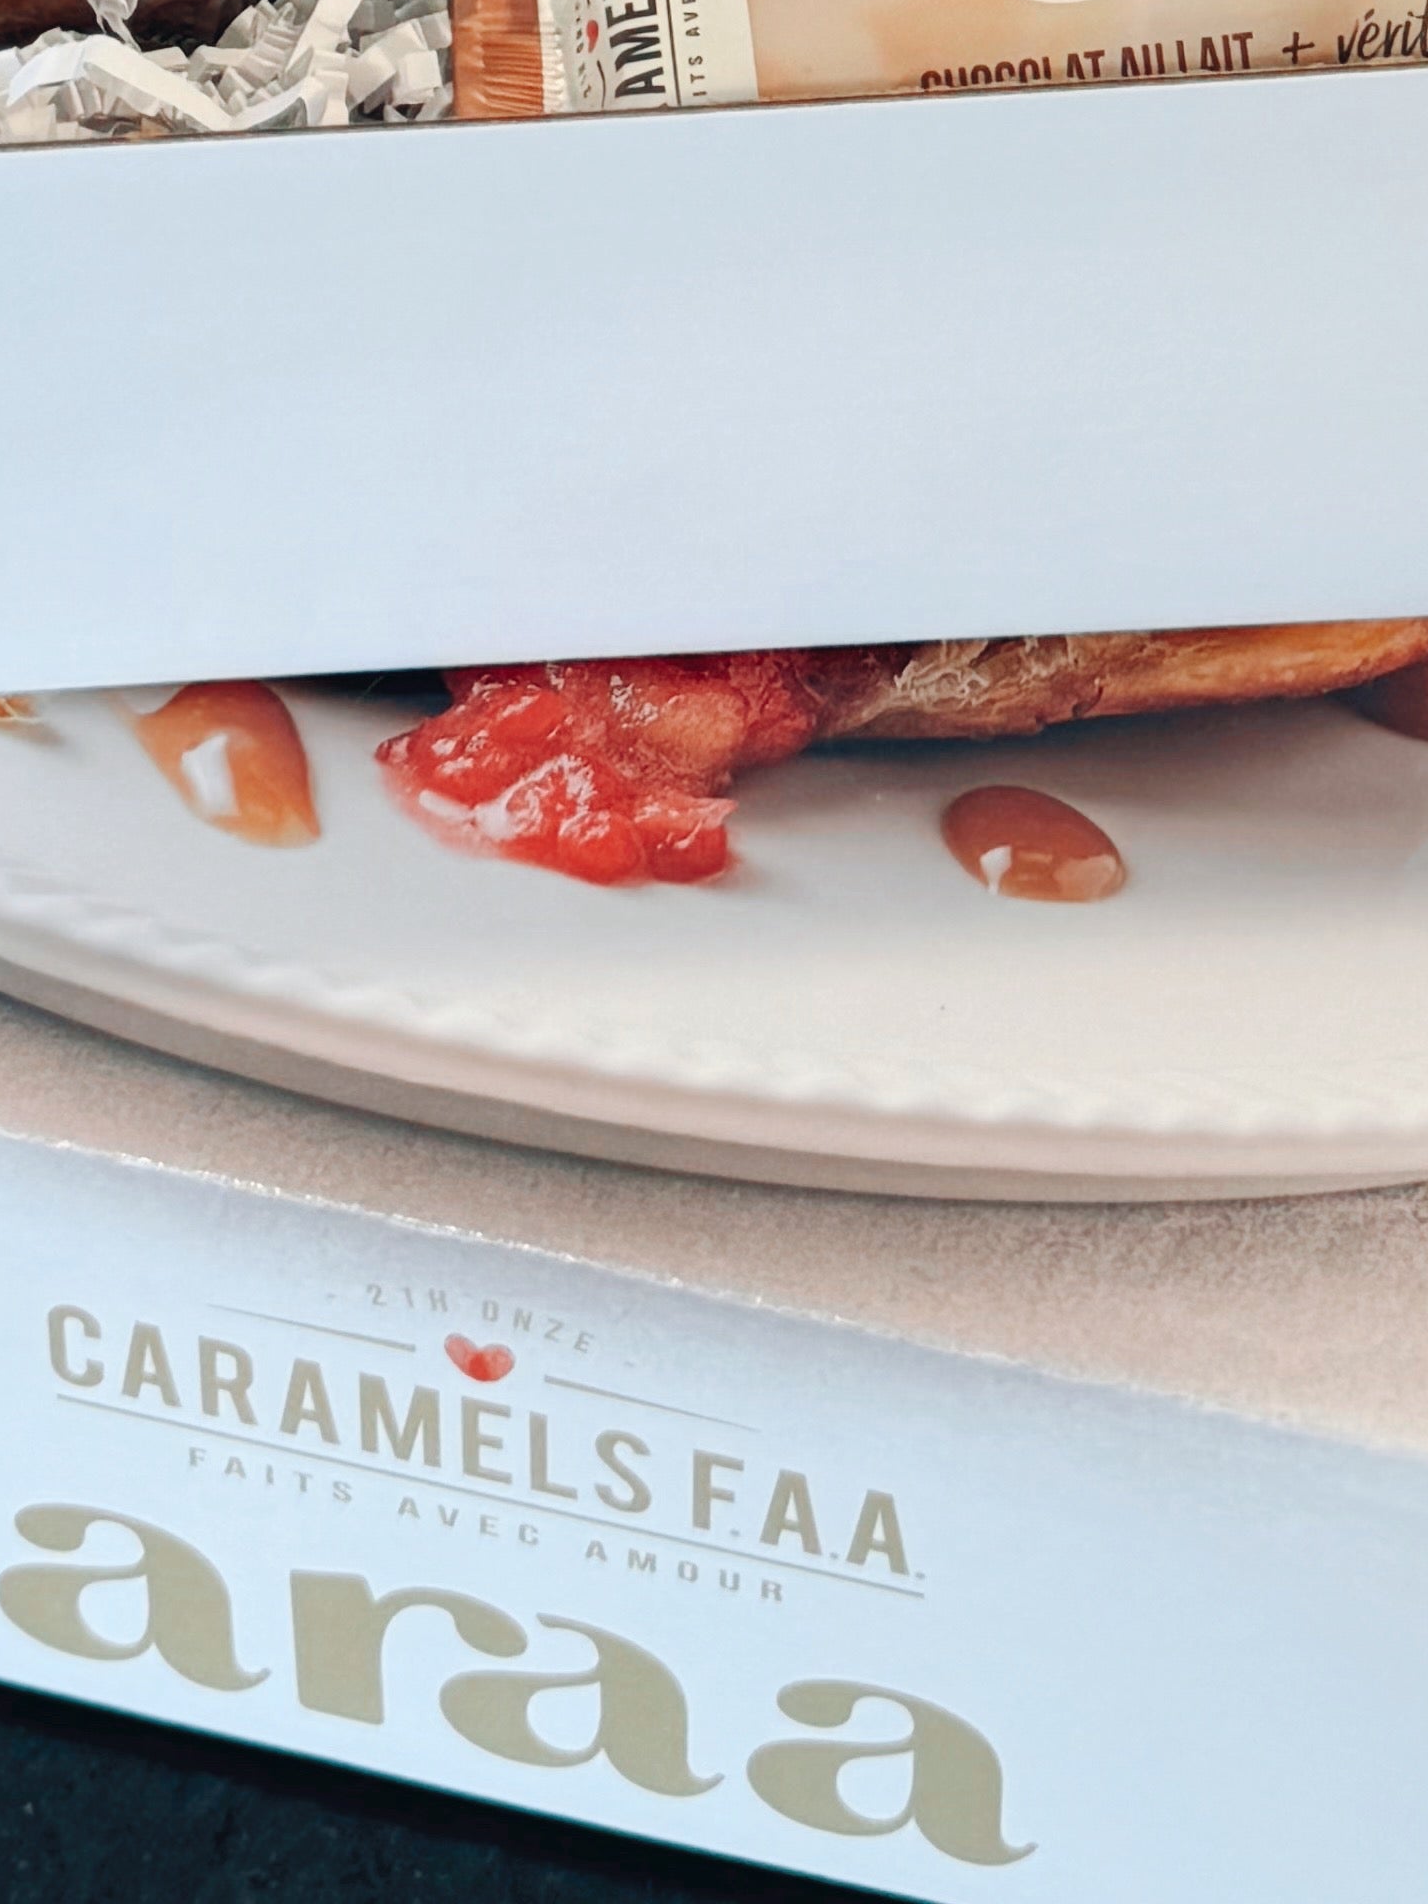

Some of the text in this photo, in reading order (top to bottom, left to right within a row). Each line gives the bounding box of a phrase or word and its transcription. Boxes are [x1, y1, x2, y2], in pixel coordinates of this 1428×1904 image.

[365, 1282, 595, 1355] 21H ONZE
[45, 1302, 926, 1582] CARAMELS F.A.A.
[187, 1445, 786, 1604] FAITS AVEC AMOUR
